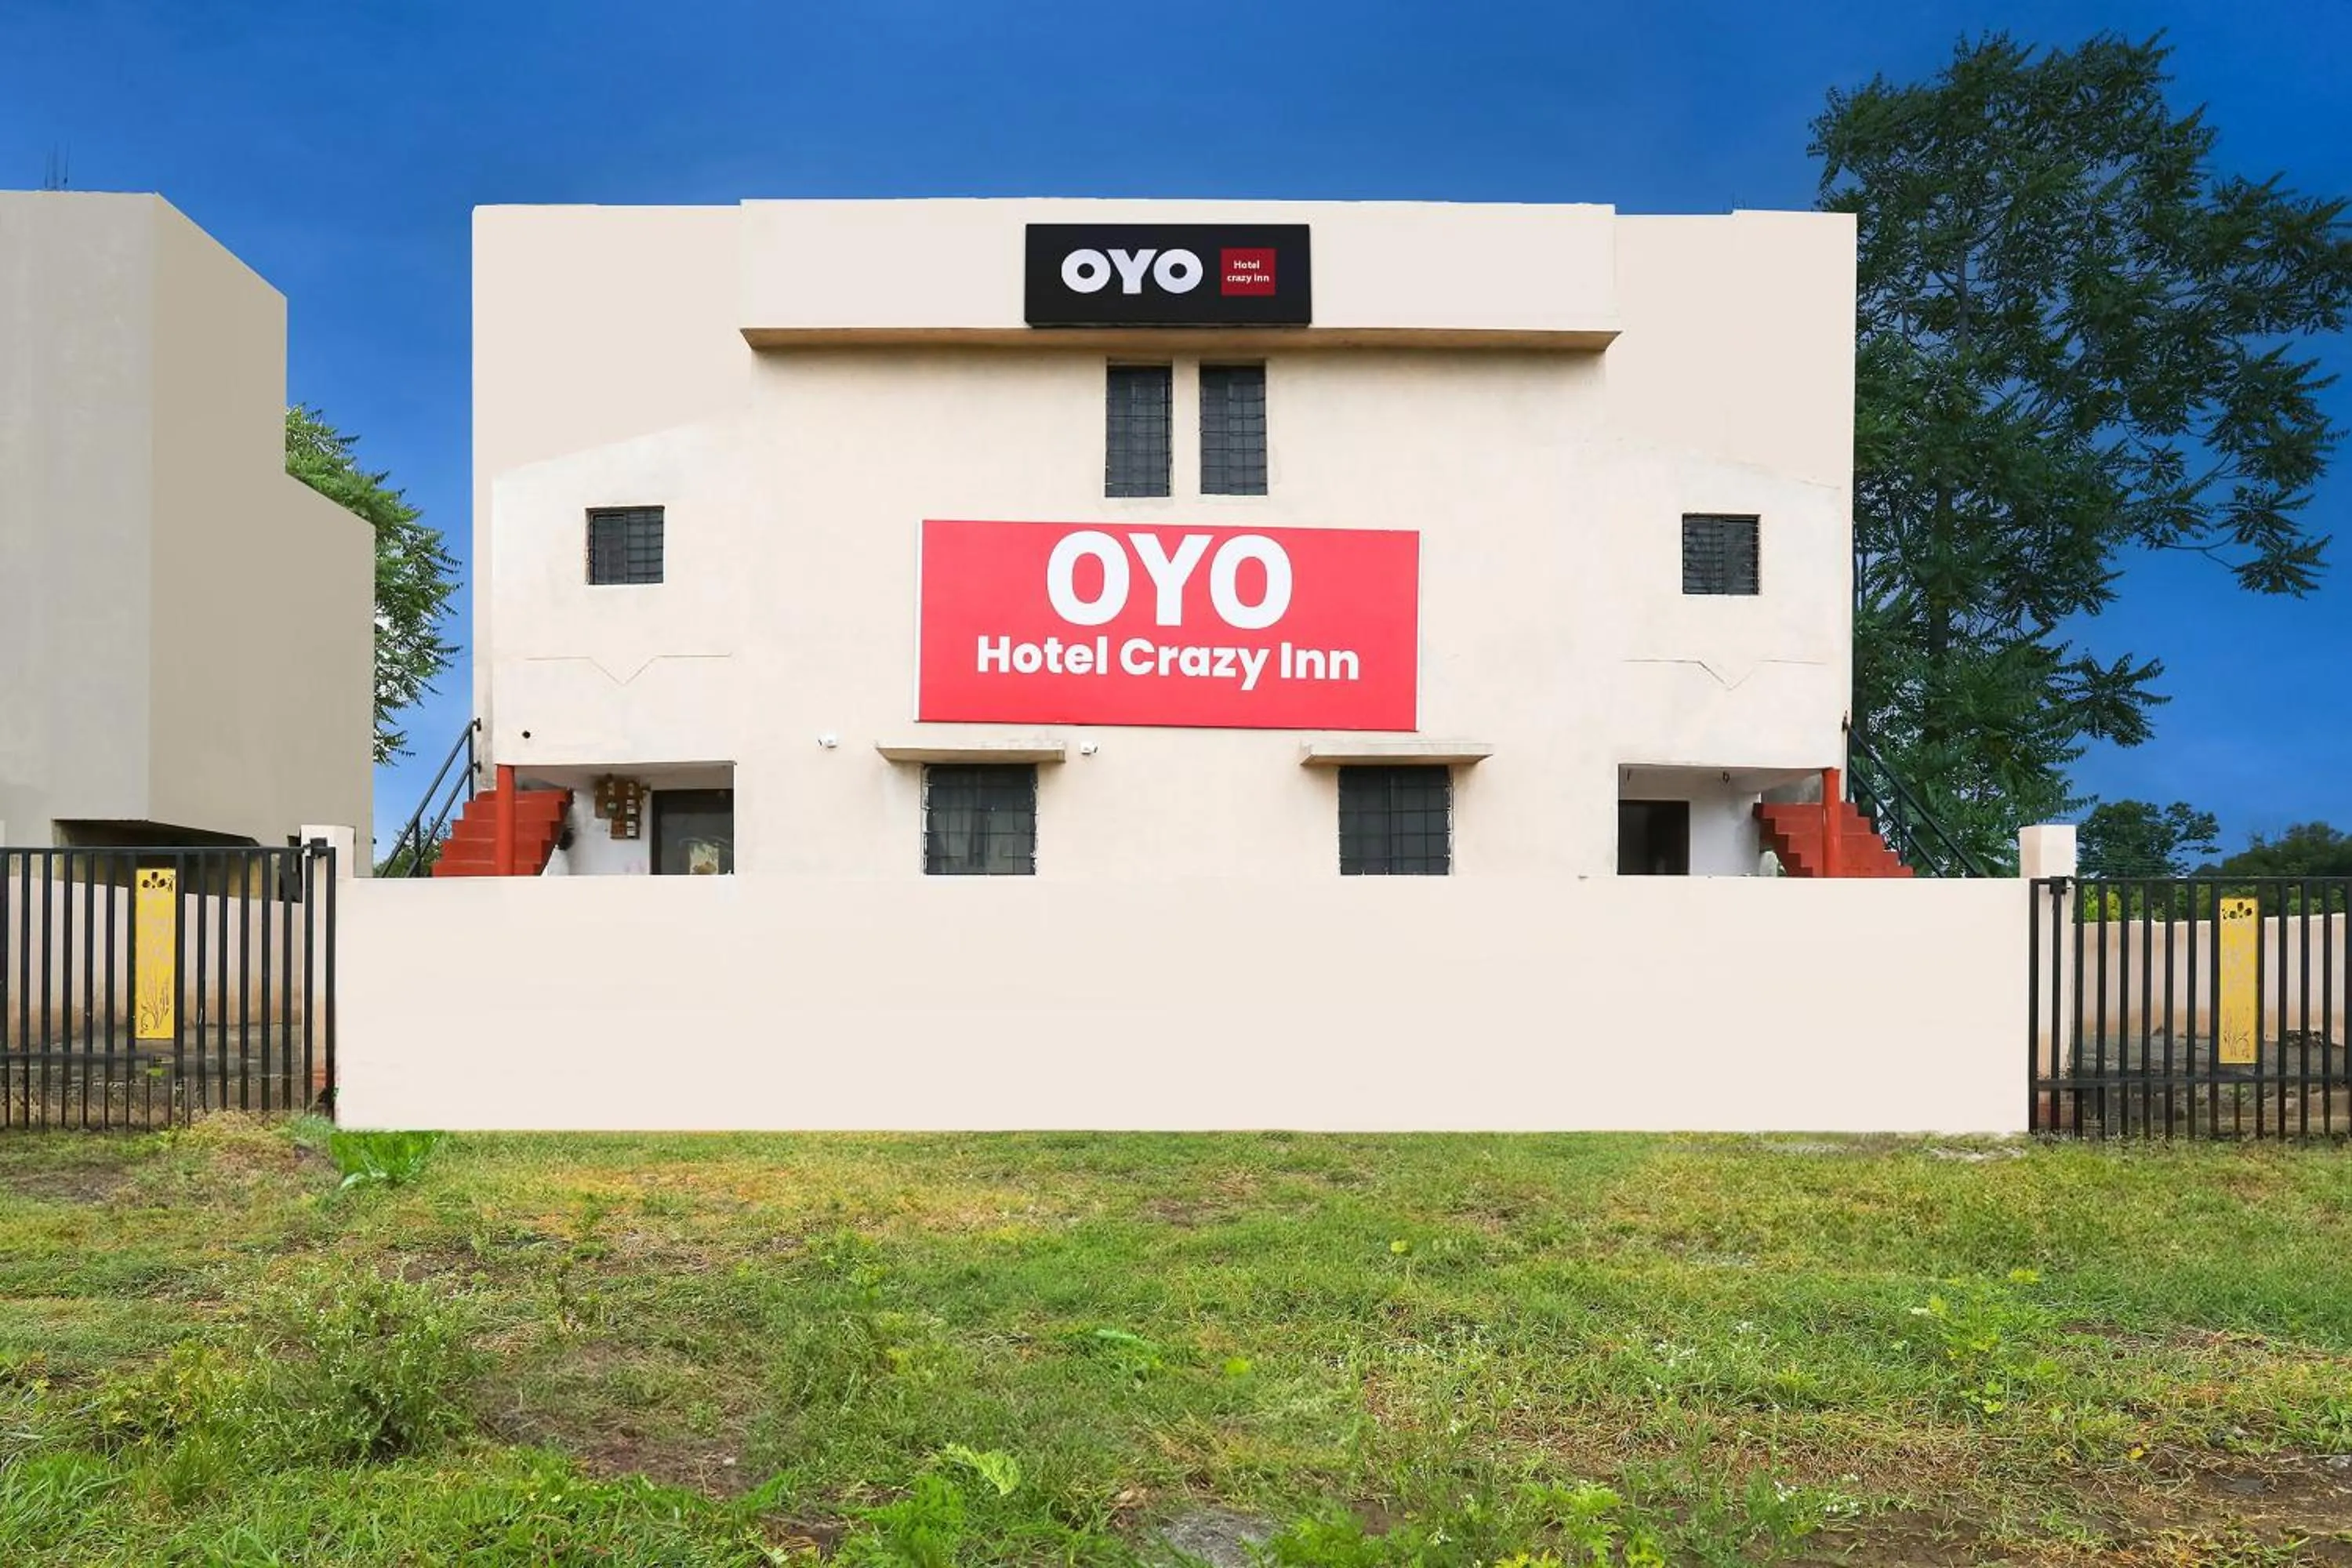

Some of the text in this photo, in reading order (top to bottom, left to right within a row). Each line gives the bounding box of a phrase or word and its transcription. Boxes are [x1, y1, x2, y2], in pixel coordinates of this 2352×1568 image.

[1061, 249, 1203, 294] OYO
[1227, 275, 1252, 284] crazy
[1233, 260, 1260, 269] Hotel
[1047, 530, 1293, 630] OYO
[978, 635, 1359, 691] Hotel Crazy Inn
